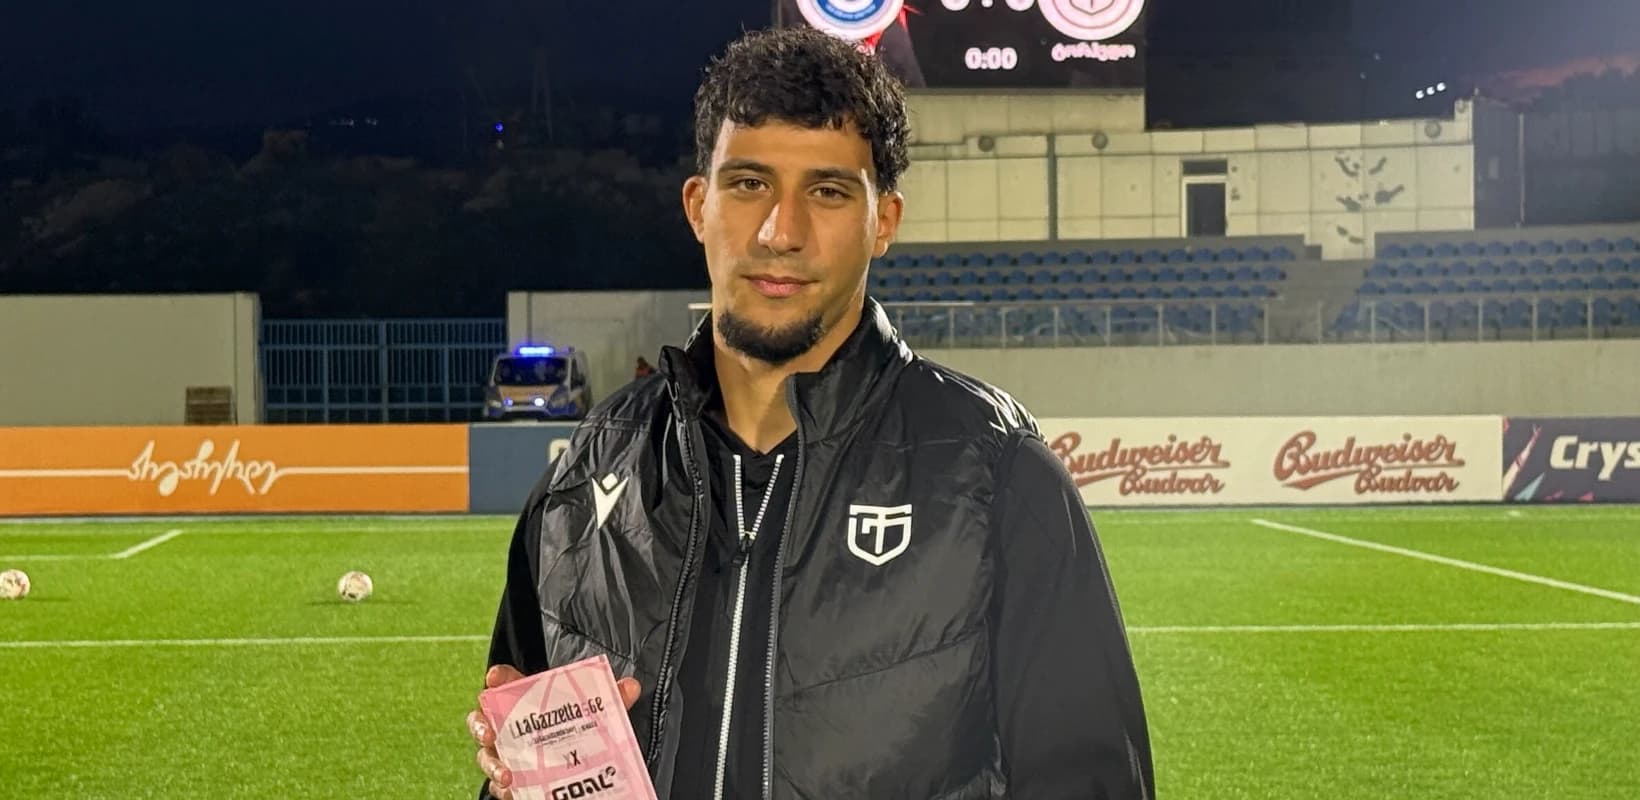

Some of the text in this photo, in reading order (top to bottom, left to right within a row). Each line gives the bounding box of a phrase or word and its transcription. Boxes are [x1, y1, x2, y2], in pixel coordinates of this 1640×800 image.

[965, 47, 1018, 70] 0:00
[1273, 430, 1465, 481] Budweiser
[1119, 465, 1226, 496] Budvar
[1354, 464, 1460, 495] Budvar
